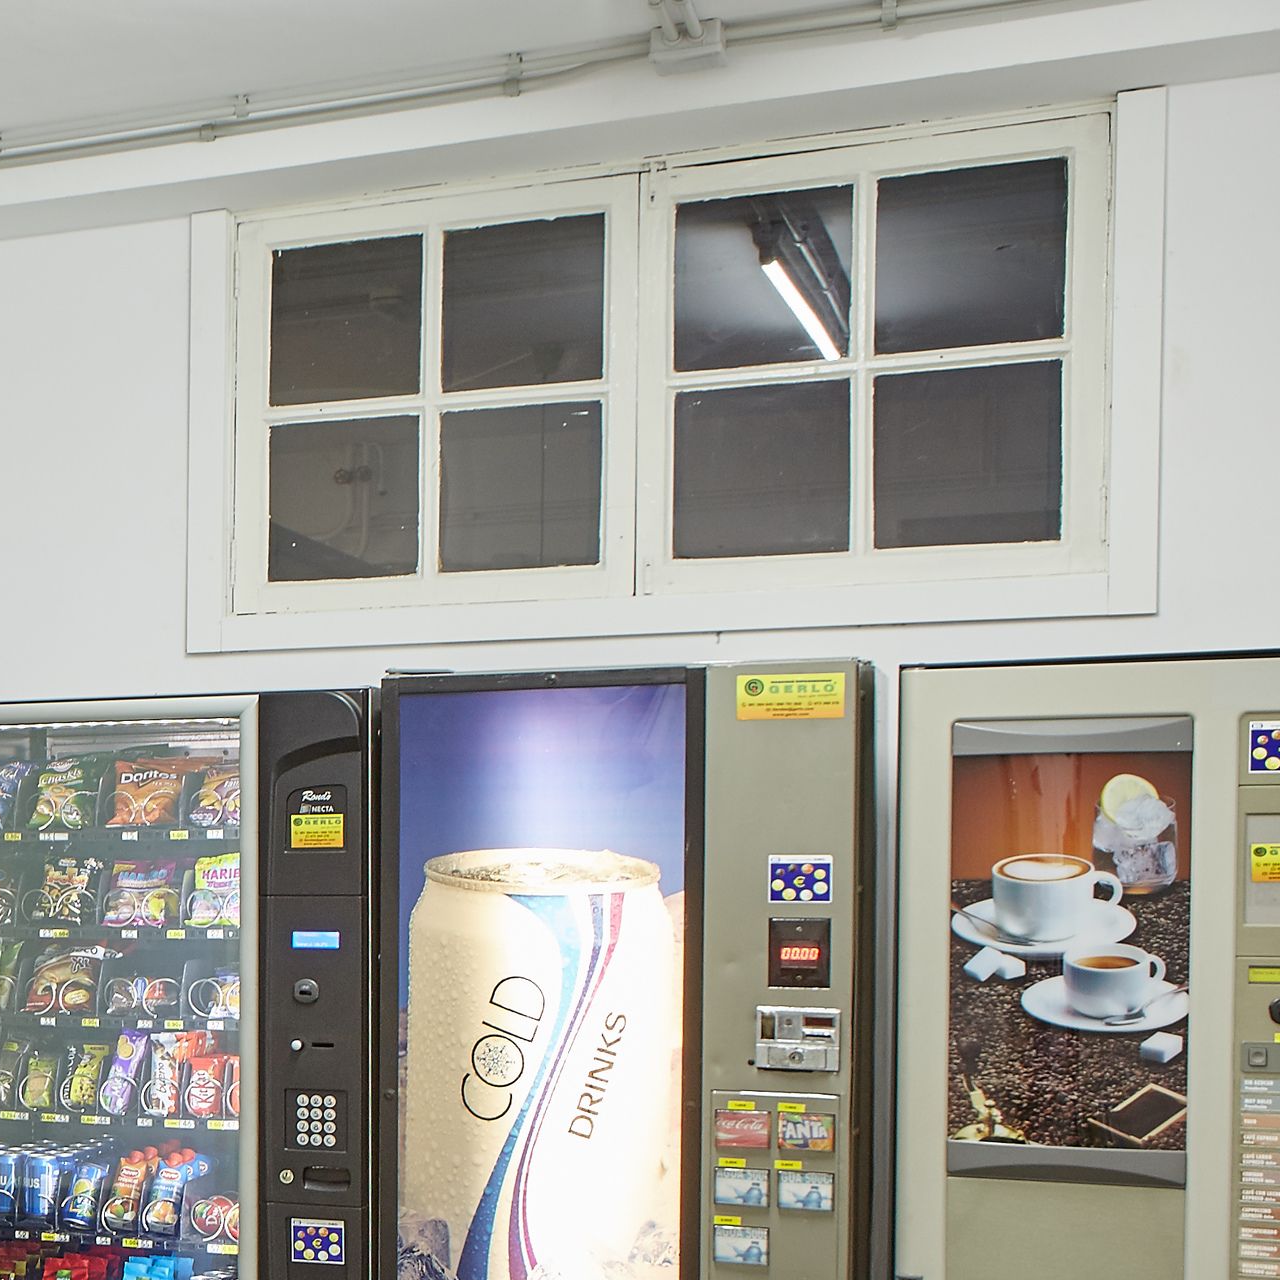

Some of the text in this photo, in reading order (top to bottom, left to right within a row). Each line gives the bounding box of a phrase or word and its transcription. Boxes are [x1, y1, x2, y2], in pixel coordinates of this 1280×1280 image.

[769, 684, 834, 693] GERLO
[120, 769, 178, 785] Doritos
[461, 976, 546, 1121] COLD
[567, 1012, 627, 1139] DRINKS
